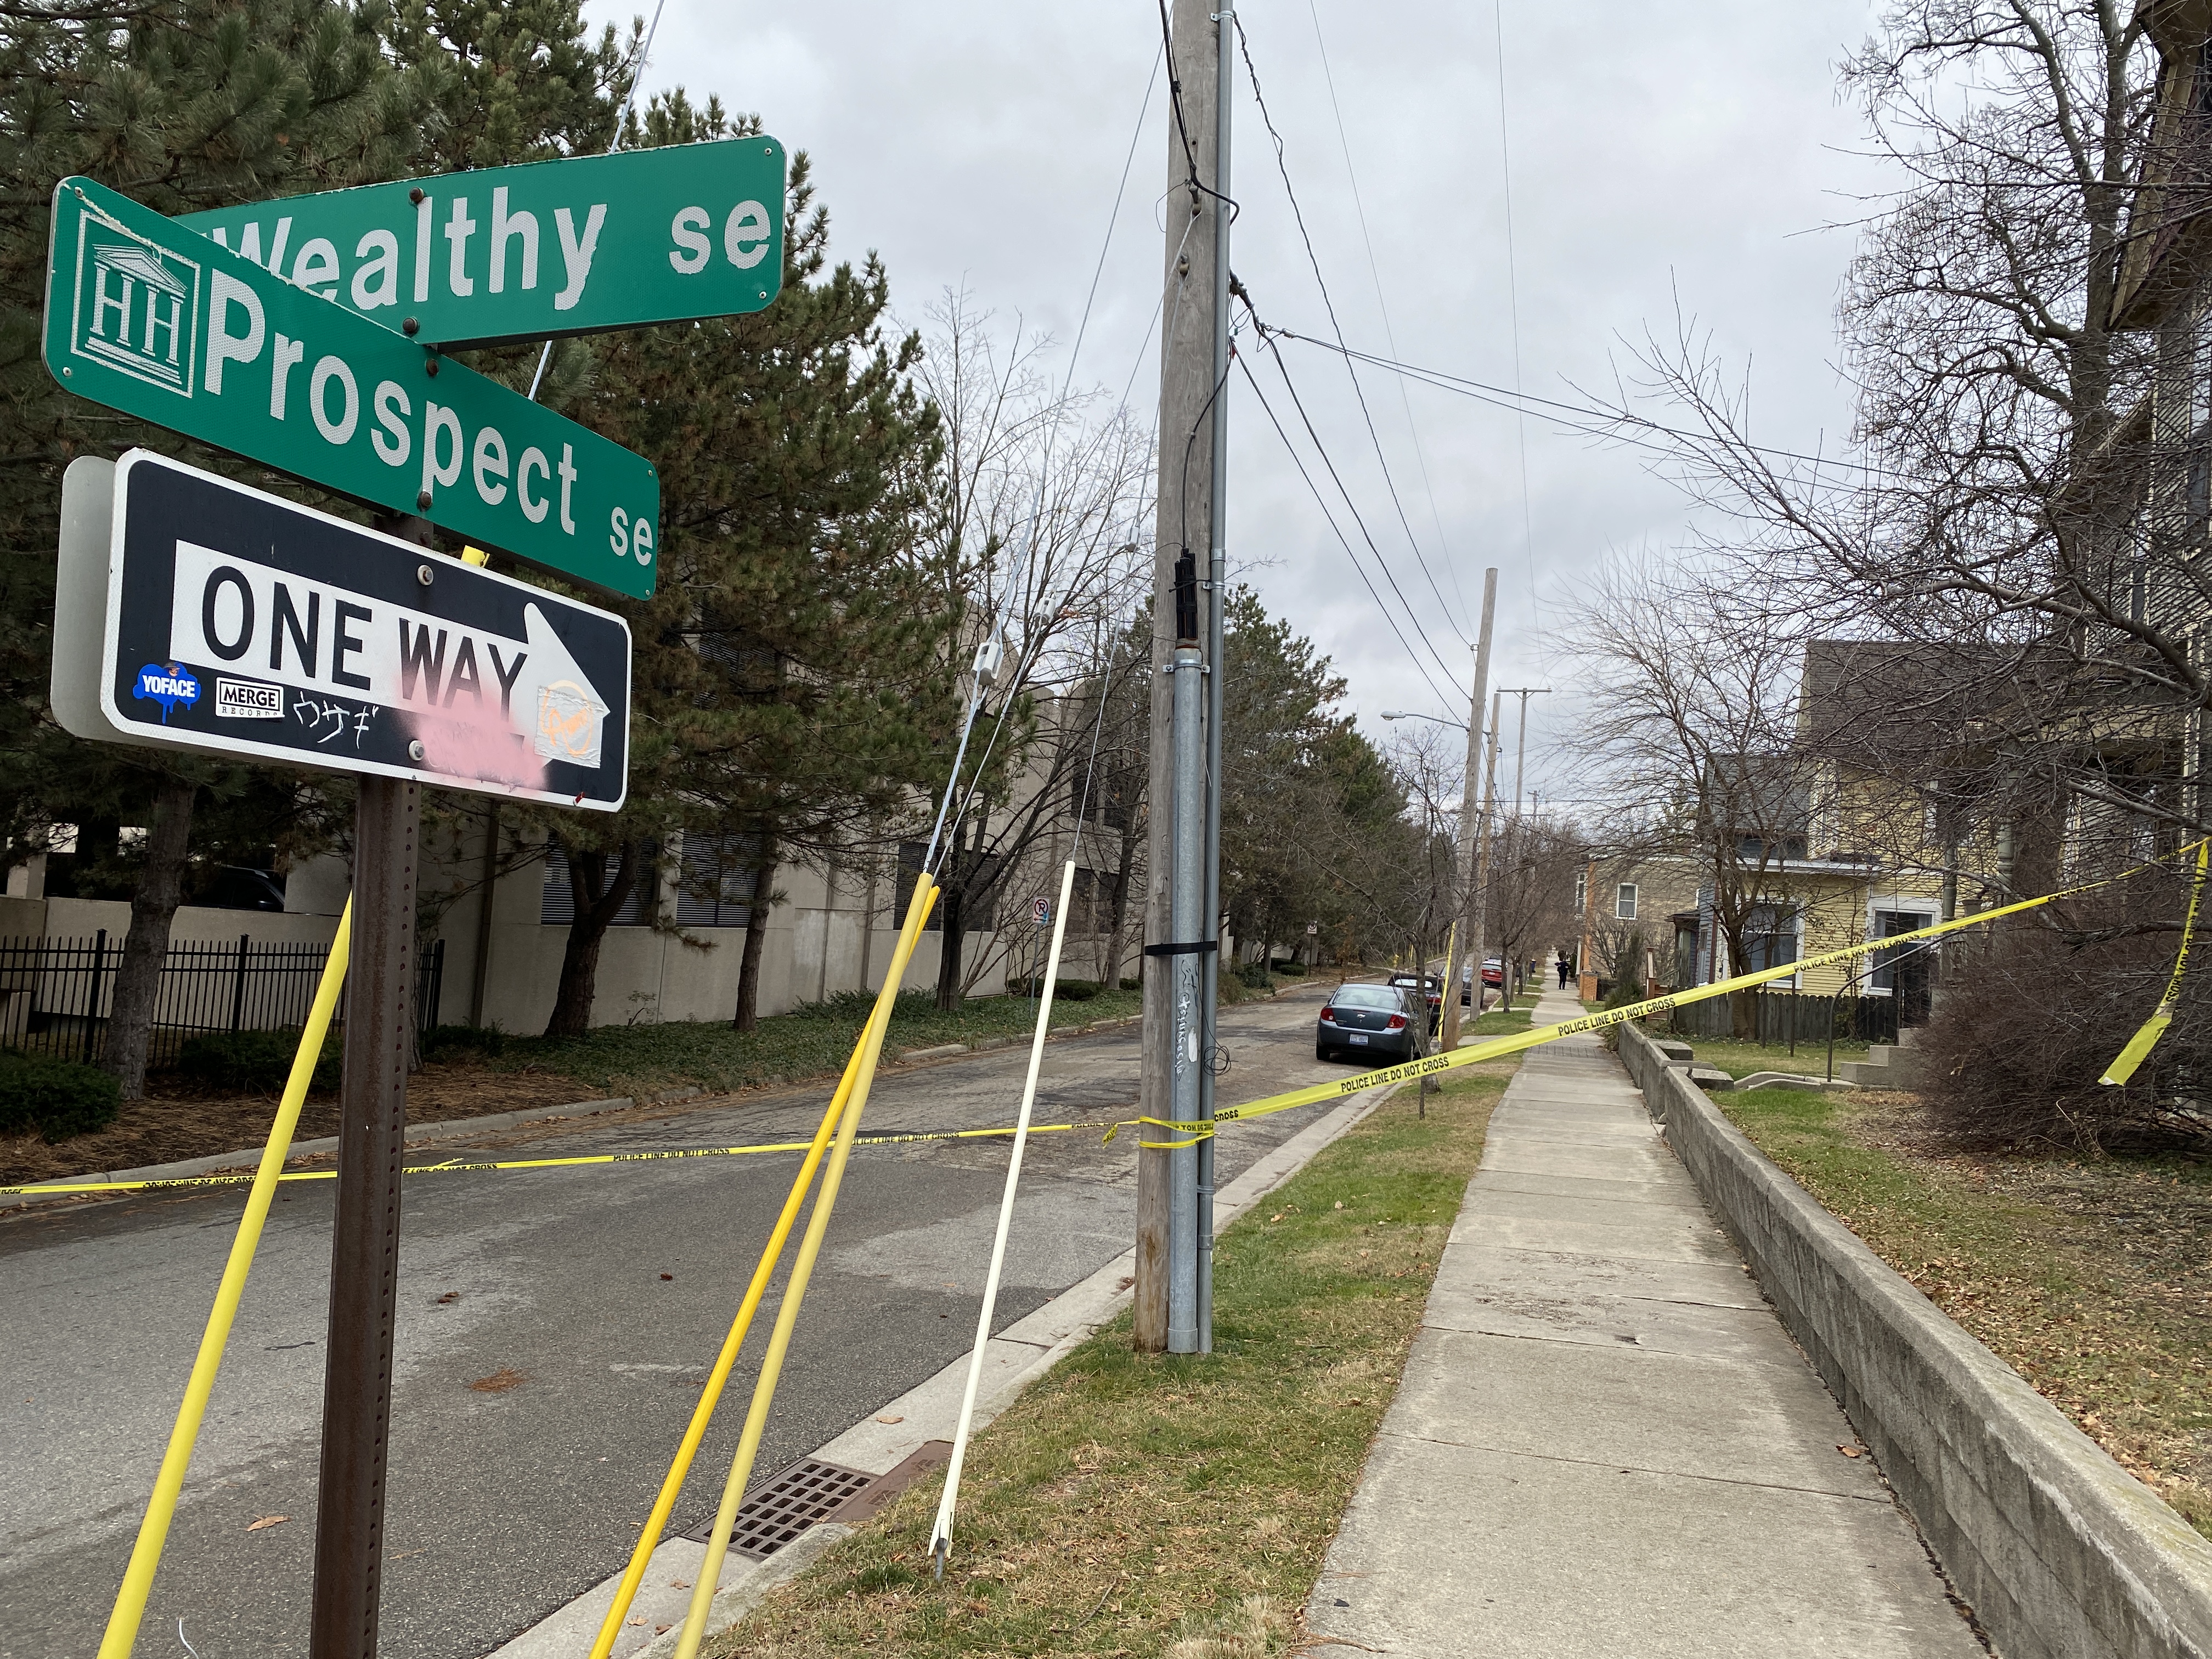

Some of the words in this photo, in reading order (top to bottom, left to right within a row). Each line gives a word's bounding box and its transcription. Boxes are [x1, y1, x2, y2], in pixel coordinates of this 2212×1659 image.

[212, 186, 607, 311] Wealthy
[669, 200, 771, 275] se
[205, 268, 577, 536] Prospect
[610, 506, 653, 566] se
[202, 566, 372, 690] ONE
[399, 618, 528, 723] WAY
[142, 675, 196, 698] YOFACE
[223, 686, 276, 707] MERGE
[1793, 958, 1827, 973] POLICE
[1829, 952, 1849, 963] LINE
[1852, 949, 1865, 957] DO
[1867, 943, 1886, 953] NOT
[1558, 1020, 1589, 1036] POLICE
[1590, 1014, 1611, 1028] LINE
[1611, 1011, 1624, 1022] DO
[1626, 1006, 1645, 1018] NOT
[1646, 997, 1676, 1013] CROSS
[1341, 1077, 1369, 1093] POLICE
[1371, 1072, 1389, 1086] LINE
[1390, 1069, 1402, 1081] DO
[1403, 1064, 1420, 1077] NOT
[1422, 1056, 1449, 1072] CROSS
[702, 1148, 730, 1156] CROSS
